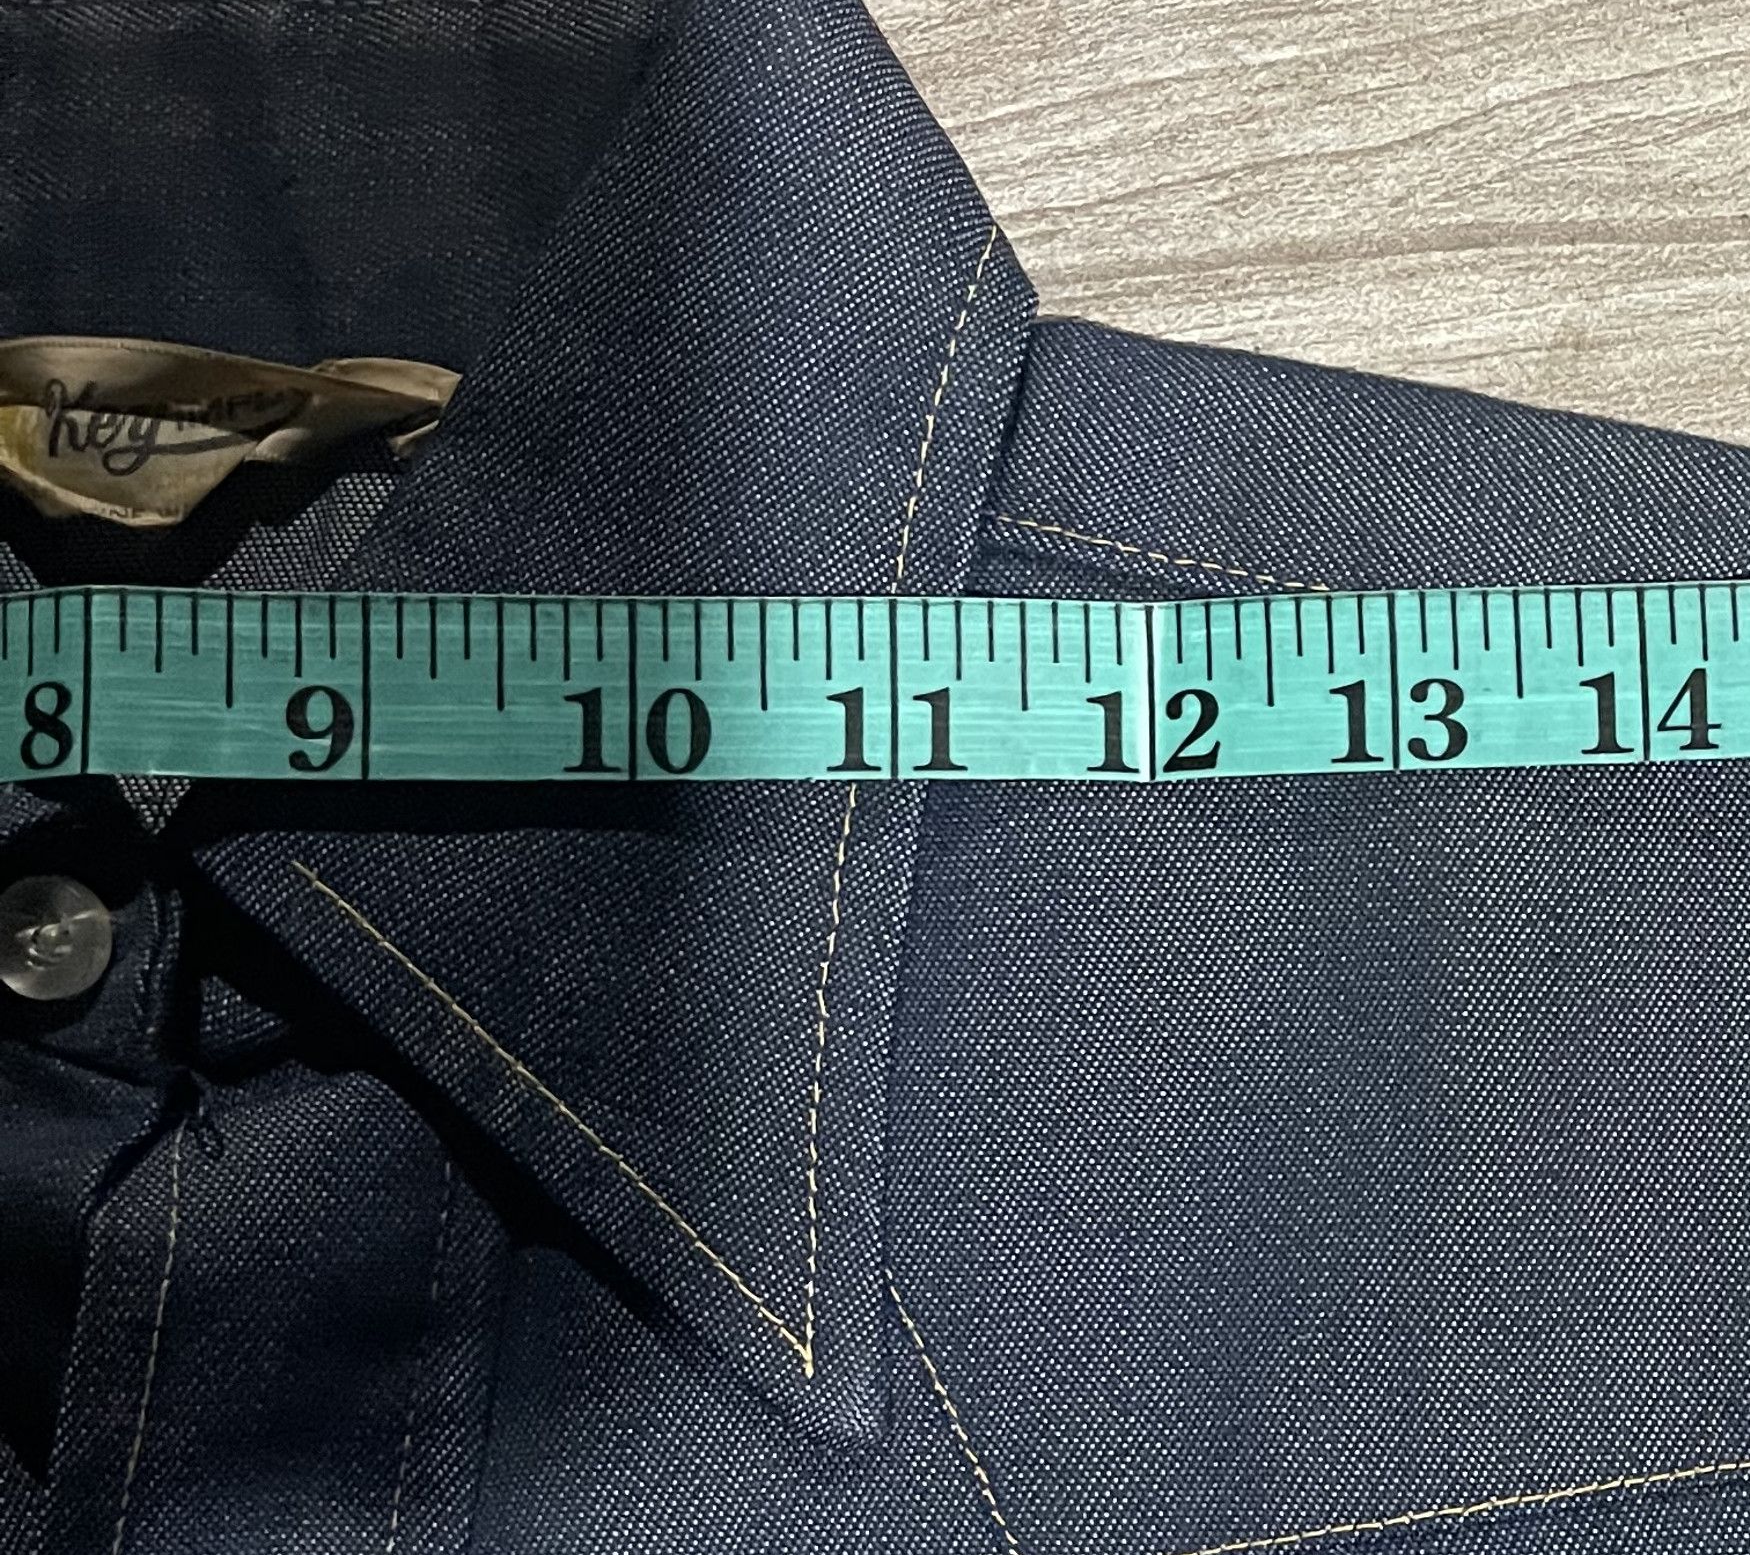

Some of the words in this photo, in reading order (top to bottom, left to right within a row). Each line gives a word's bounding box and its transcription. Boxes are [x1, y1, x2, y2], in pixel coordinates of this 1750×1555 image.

[19, 680, 74, 773] 8
[285, 685, 355, 774] 9
[562, 686, 713, 775] 10
[825, 686, 969, 772] 11
[1086, 689, 1222, 774] 12
[1329, 678, 1469, 764] 13
[1579, 668, 1722, 755] 14
